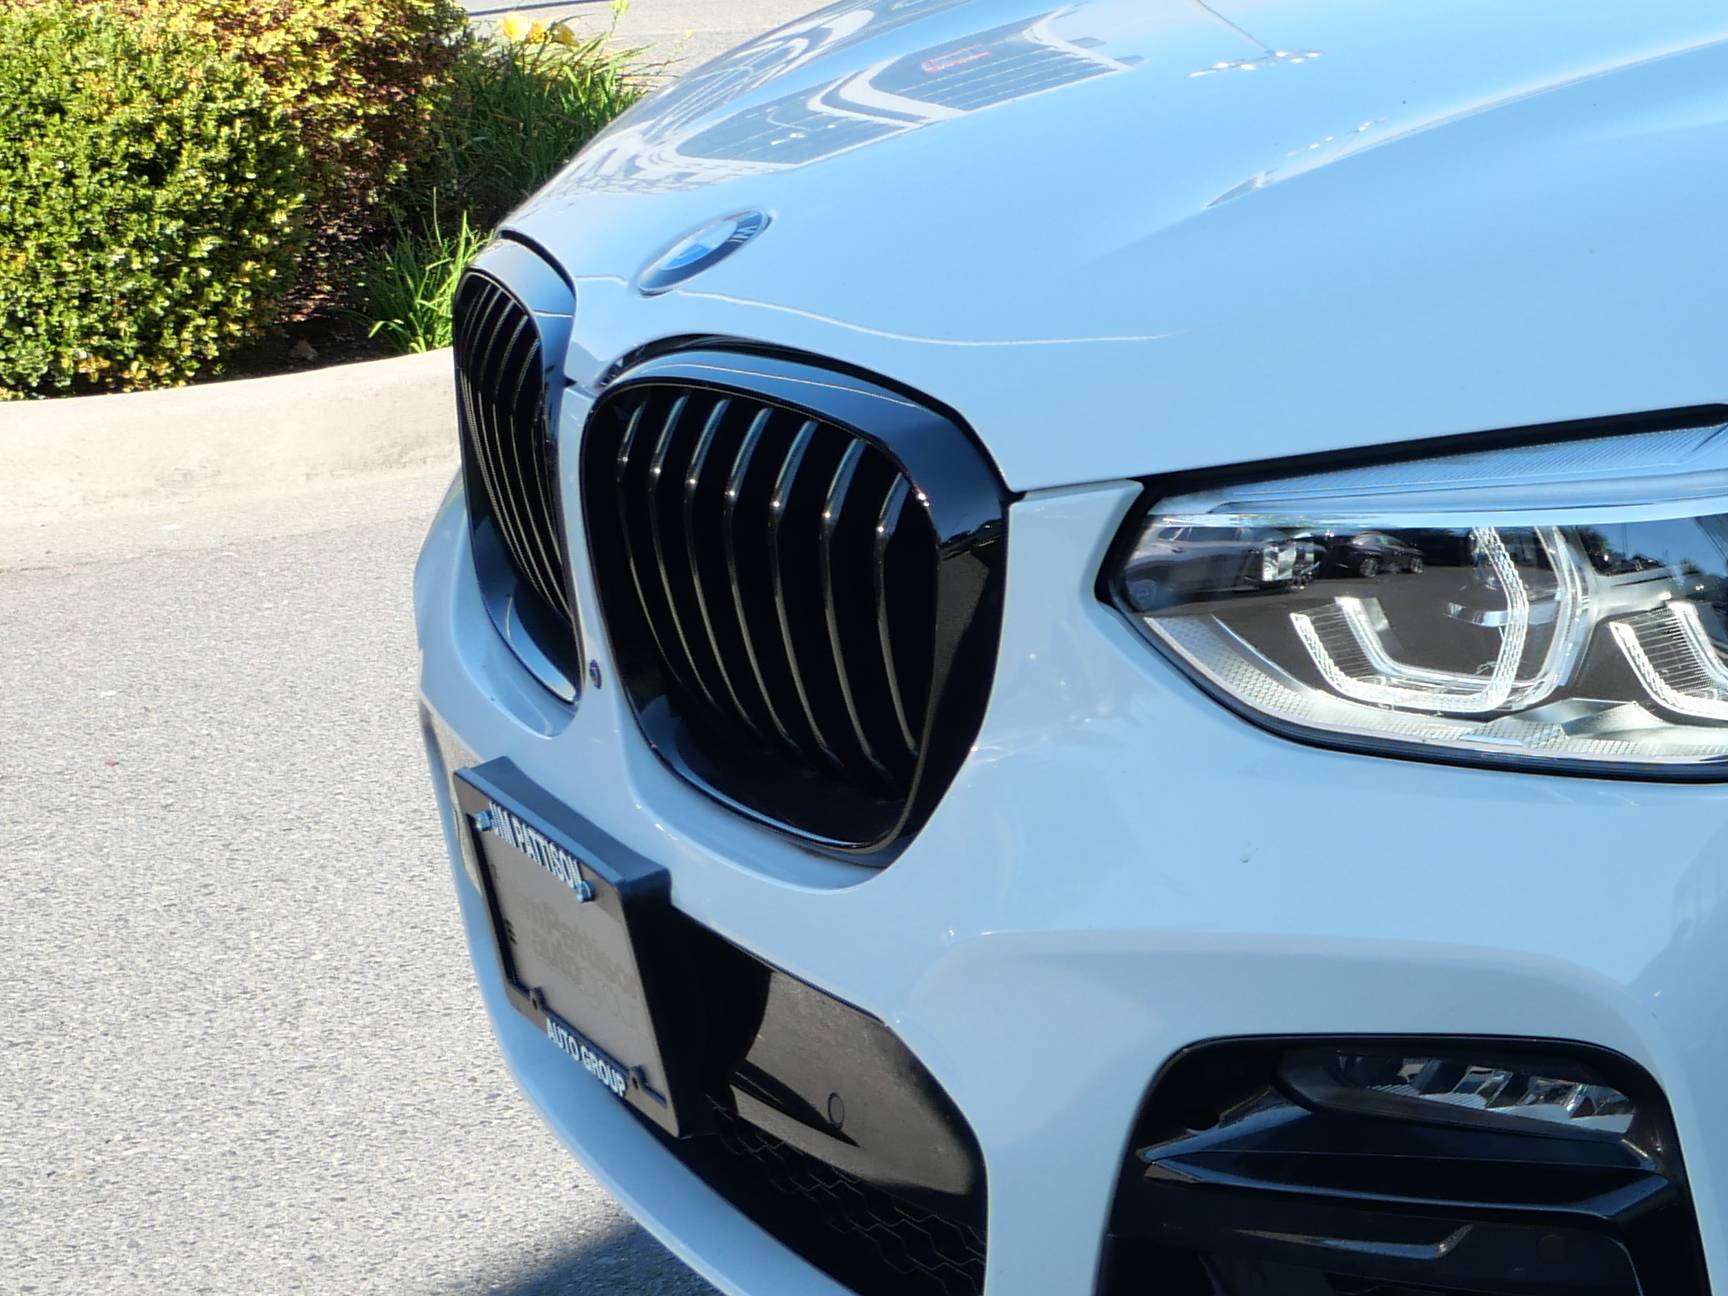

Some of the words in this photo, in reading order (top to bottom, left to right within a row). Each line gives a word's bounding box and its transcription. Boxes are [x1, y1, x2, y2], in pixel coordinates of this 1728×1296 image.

[511, 814, 584, 892] PATTISON
[546, 1017, 580, 1061] AUTO
[580, 1045, 626, 1098] GROUP
